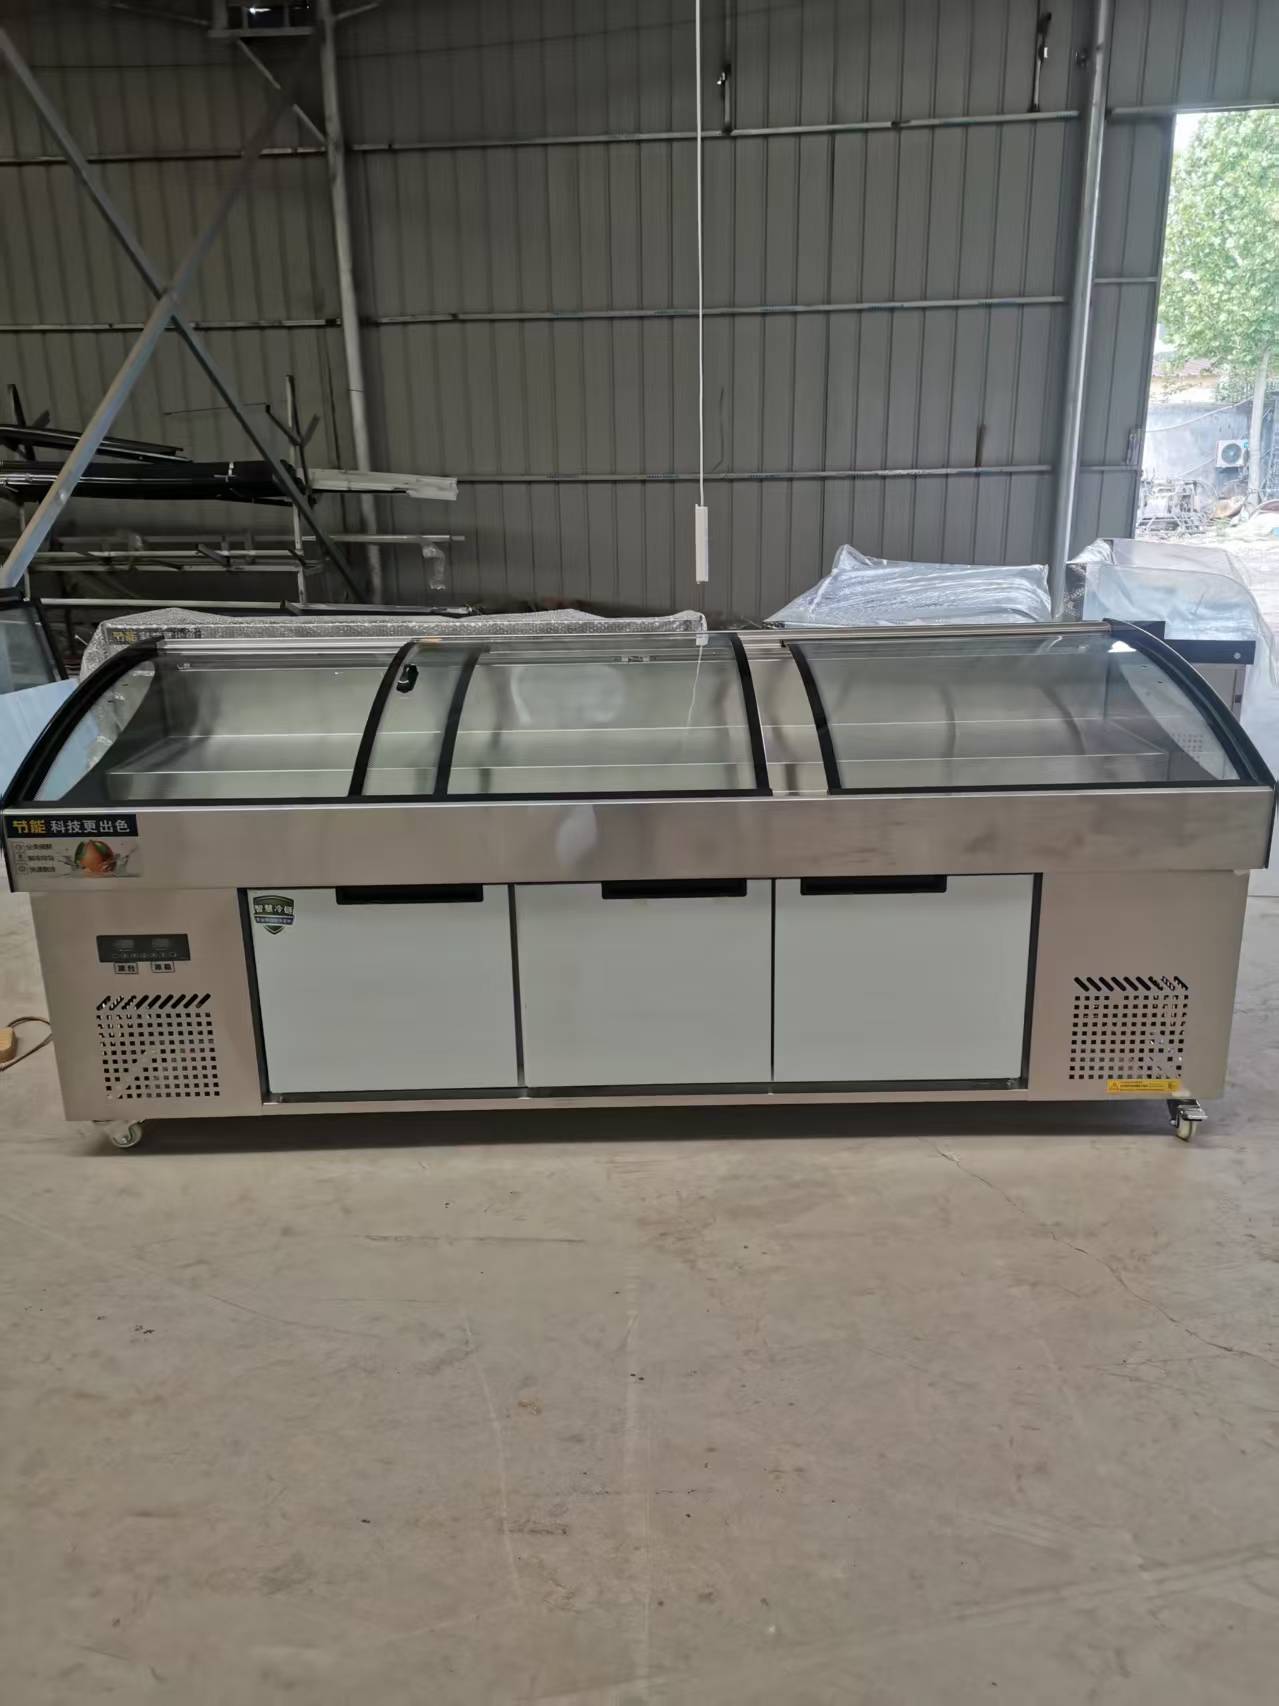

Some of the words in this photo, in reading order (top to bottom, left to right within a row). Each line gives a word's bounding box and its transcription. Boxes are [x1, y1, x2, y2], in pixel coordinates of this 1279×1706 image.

[13, 820, 46, 833] 节能
[50, 820, 130, 833] 科技更出色
